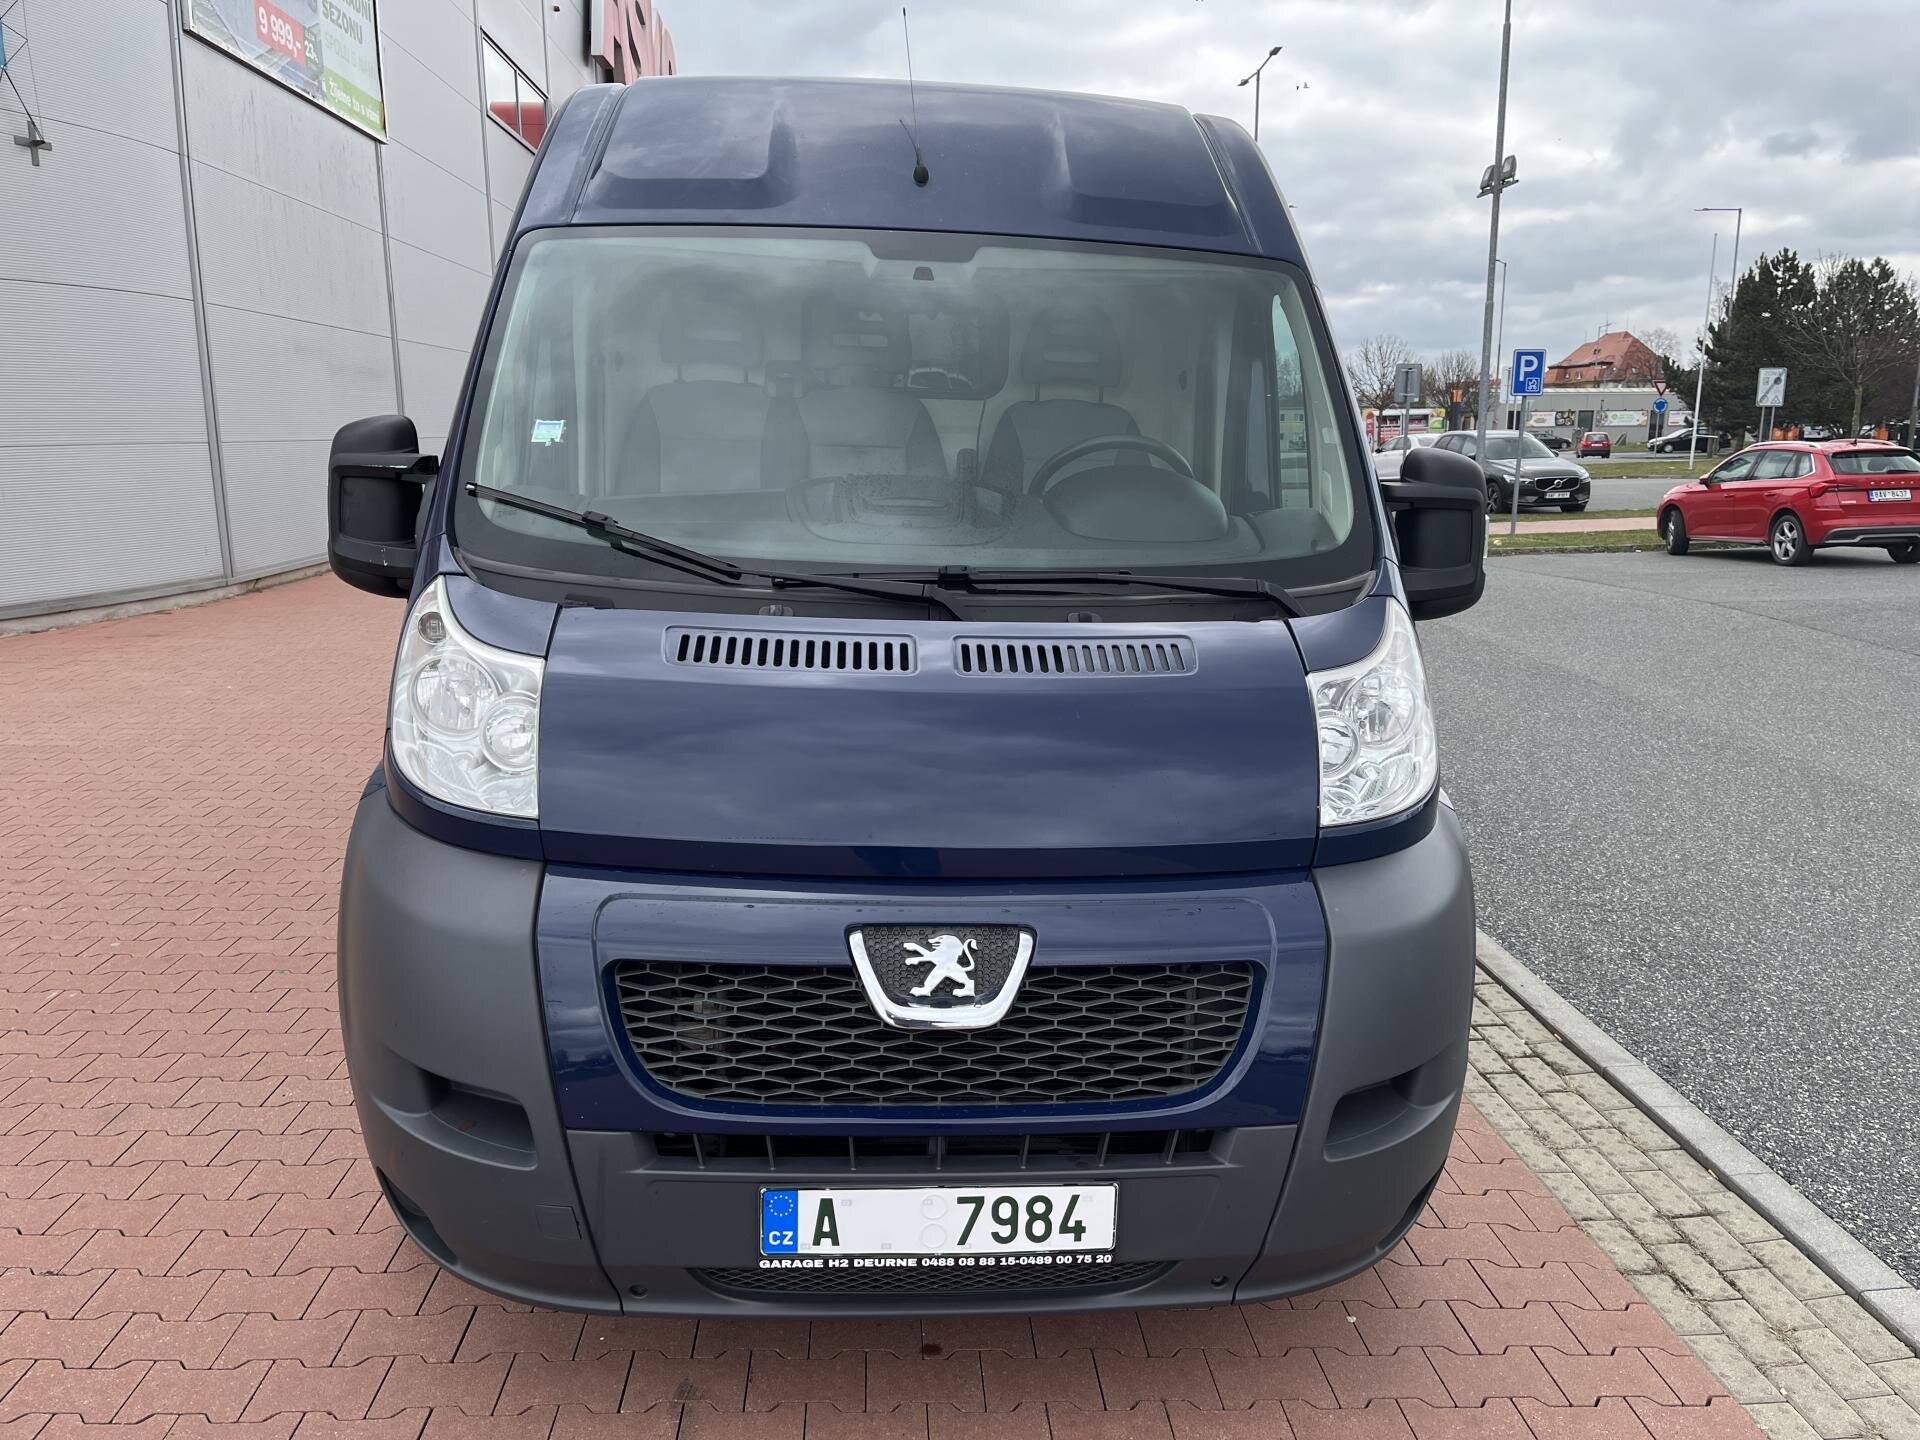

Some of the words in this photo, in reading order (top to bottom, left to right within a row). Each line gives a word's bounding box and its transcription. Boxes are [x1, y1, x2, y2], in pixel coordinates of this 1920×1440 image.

[1519, 355, 1538, 382] P
[812, 1197, 840, 1247] A
[956, 1194, 1087, 1246] 7984
[768, 1231, 794, 1245] CZ
[759, 1259, 824, 1269] GARAGE
[828, 1259, 849, 1268] H2
[854, 1258, 917, 1268] DEURNE
[921, 1257, 955, 1267] 0488
[959, 1257, 975, 1266] 08
[979, 1257, 996, 1266] 88
[999, 1256, 1053, 1266] 15-0489
[1056, 1255, 1073, 1264] 00
[1076, 1255, 1092, 1263] 75
[1096, 1254, 1112, 1263] 20
